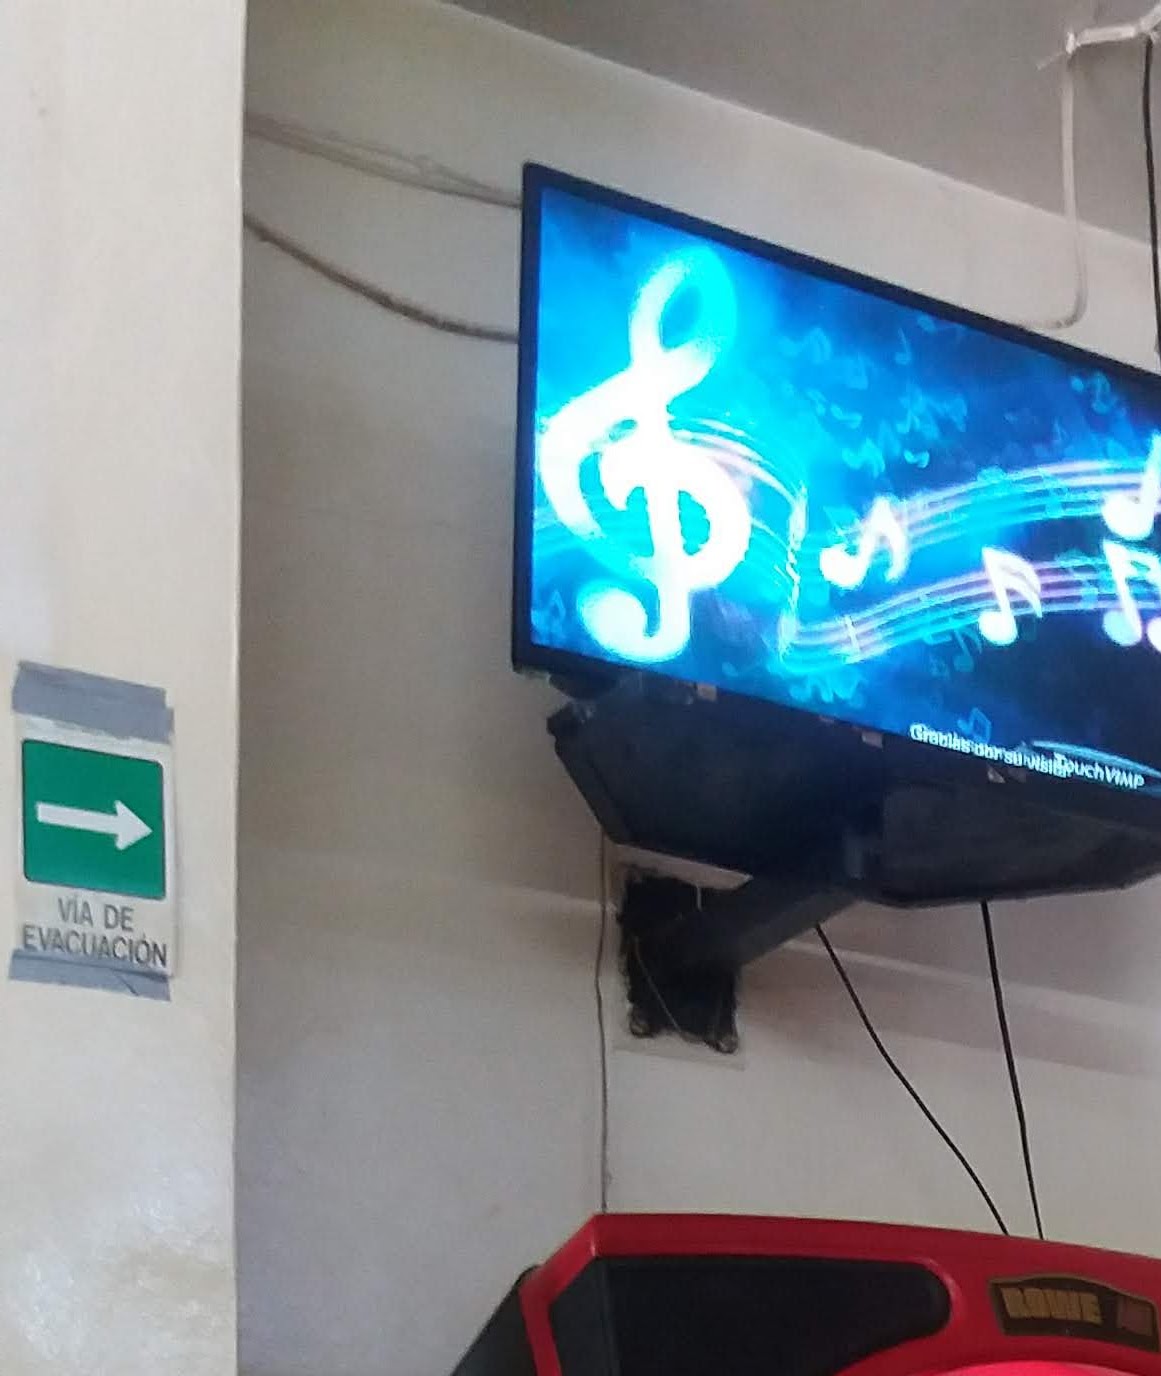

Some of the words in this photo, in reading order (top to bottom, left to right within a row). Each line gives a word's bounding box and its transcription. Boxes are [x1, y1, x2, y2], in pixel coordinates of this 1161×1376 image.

[57, 895, 94, 924] VÍA
[104, 904, 135, 931] DE
[23, 924, 168, 968] EVACUACIÓN
